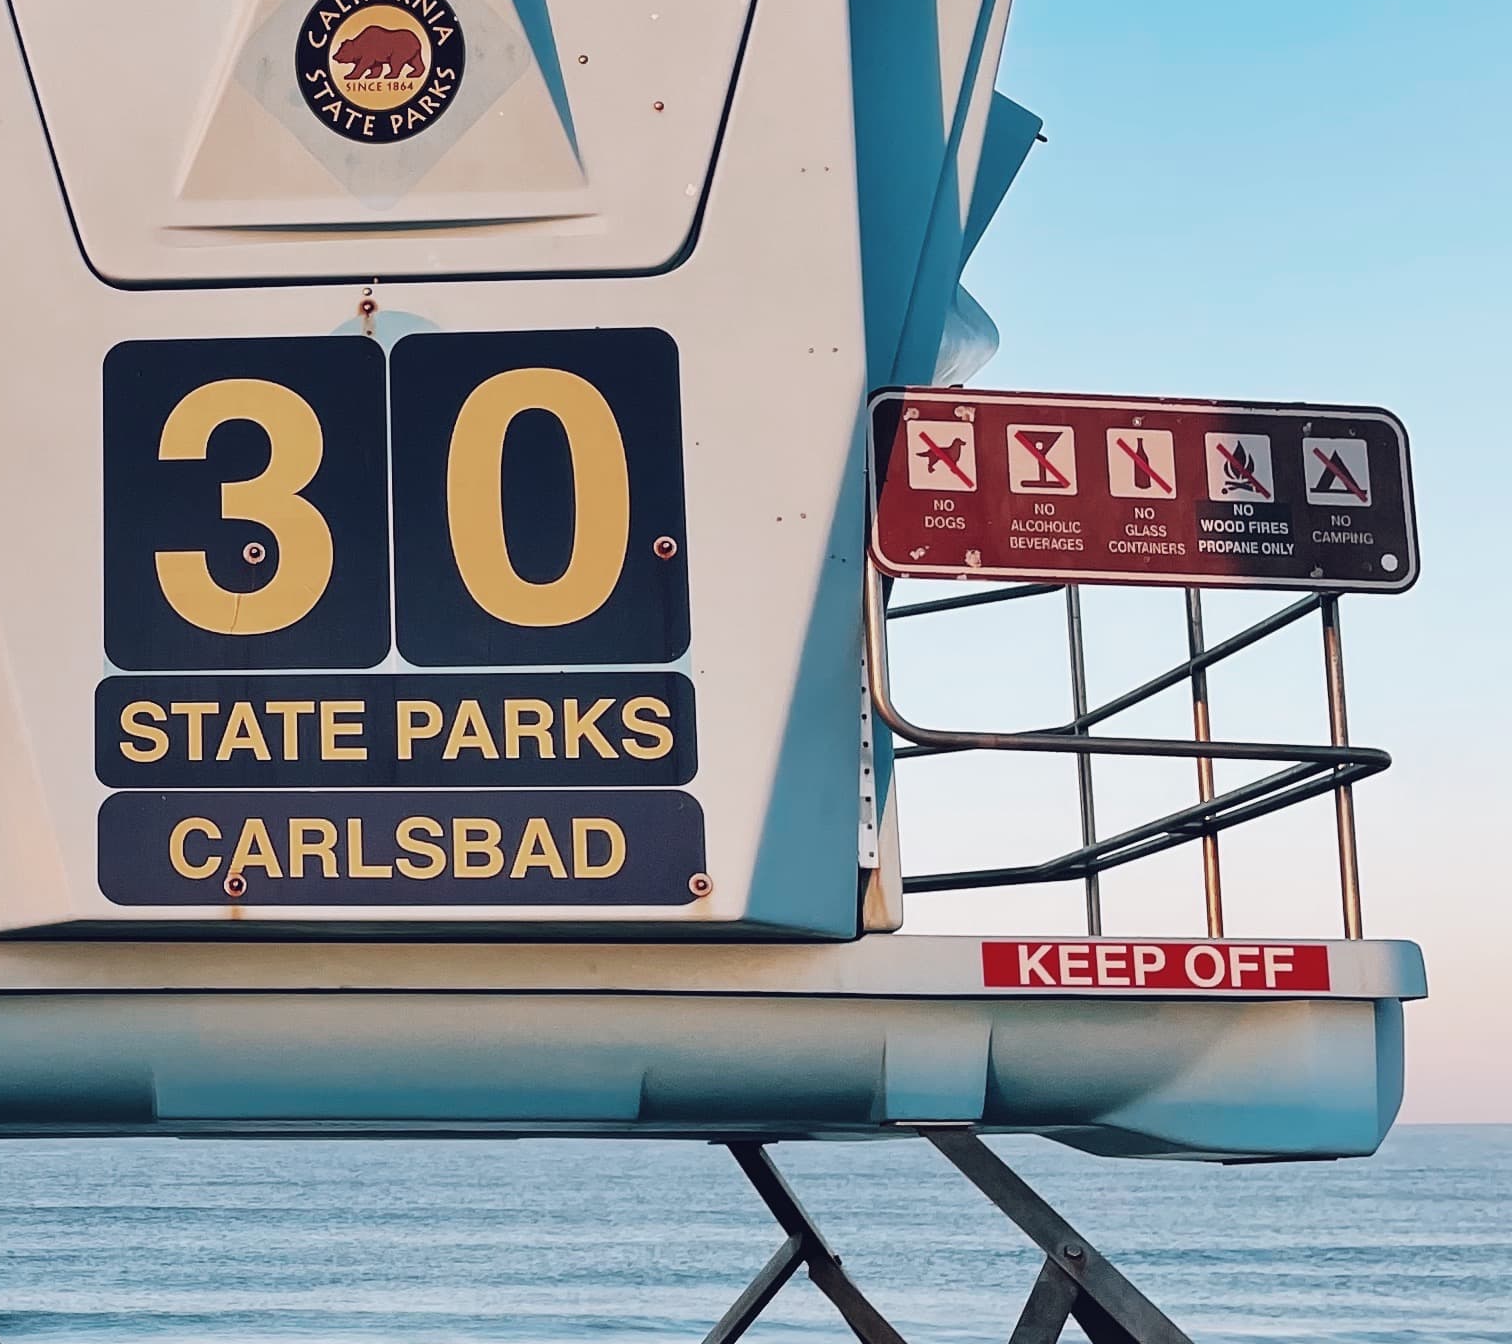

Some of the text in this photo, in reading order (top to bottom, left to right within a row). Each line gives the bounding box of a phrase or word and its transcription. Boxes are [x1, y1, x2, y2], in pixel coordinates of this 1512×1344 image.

[346, 81, 414, 92] SINCE 1864
[306, 66, 455, 136] STATE PARKS
[933, 499, 955, 512] NO
[1034, 503, 1055, 516] NO
[1233, 503, 1254, 517] NO
[1134, 507, 1155, 520] NO
[1331, 514, 1351, 527] NO
[924, 516, 966, 530] DOGS
[1010, 519, 1081, 534] ALCOHOLIC
[1200, 519, 1289, 534] WOOD FIRES
[1125, 524, 1167, 538] GLASS
[1312, 530, 1374, 545] CAMPING
[1010, 536, 1084, 551] BEVERAGES
[1108, 540, 1186, 555] CONTAINERS
[1198, 540, 1295, 556] PROPANE ONLY
[119, 697, 674, 762] STATE PARKS
[169, 816, 627, 880] CARLSBAD
[1017, 944, 1295, 988] KEEP OFF
